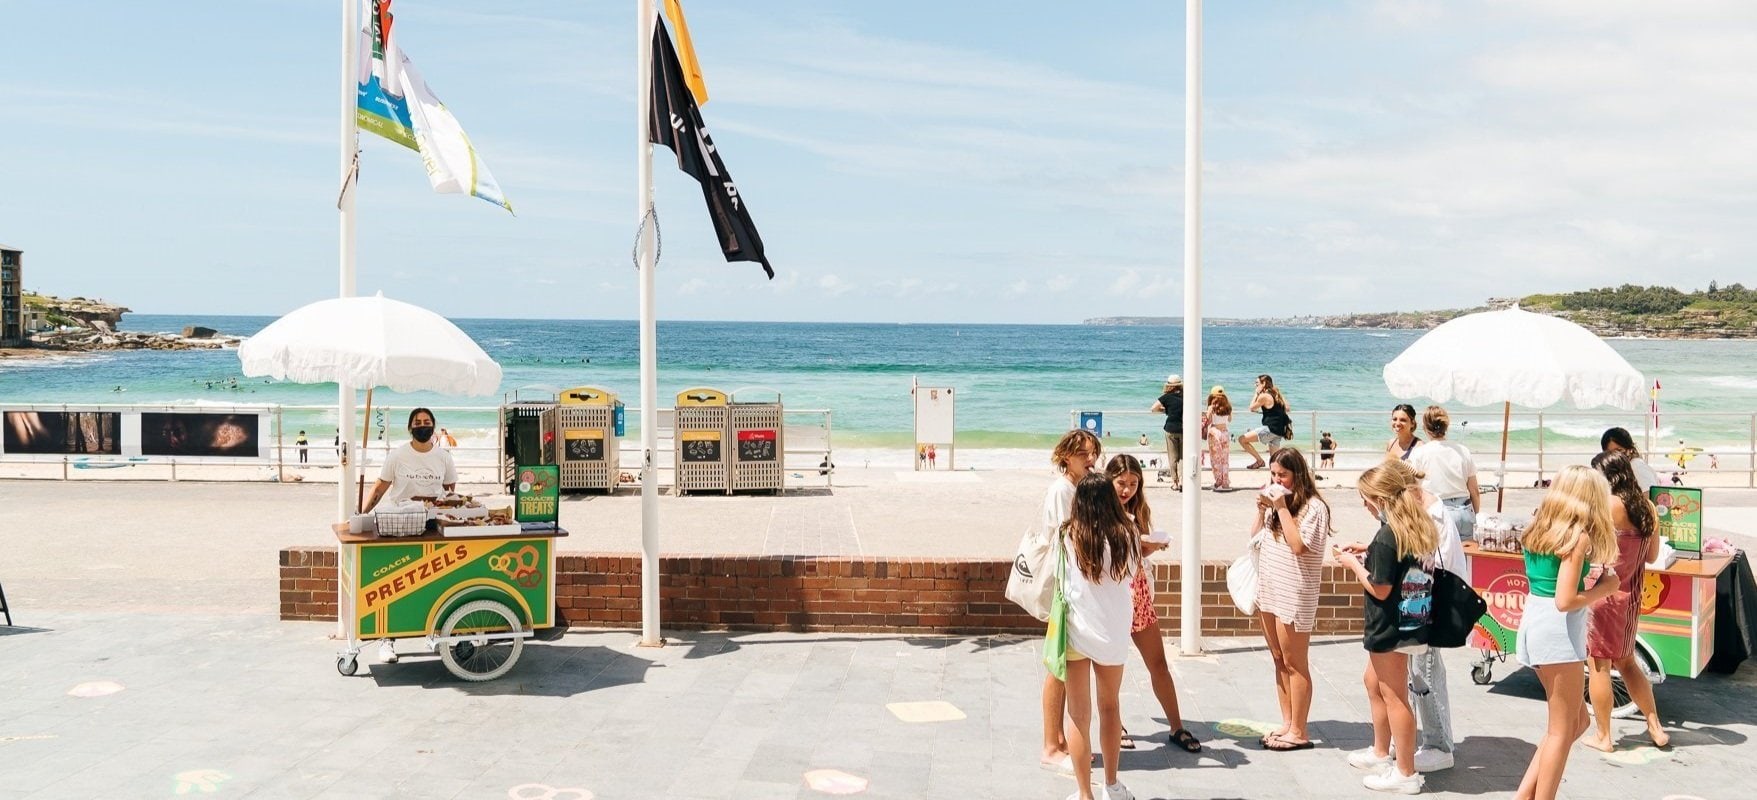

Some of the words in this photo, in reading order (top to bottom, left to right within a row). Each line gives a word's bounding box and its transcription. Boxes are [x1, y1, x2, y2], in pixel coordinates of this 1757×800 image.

[520, 501, 555, 515] TREATS
[372, 554, 412, 577] COACH
[365, 544, 468, 607] PRETZELS
[1506, 579, 1527, 588] HOT
